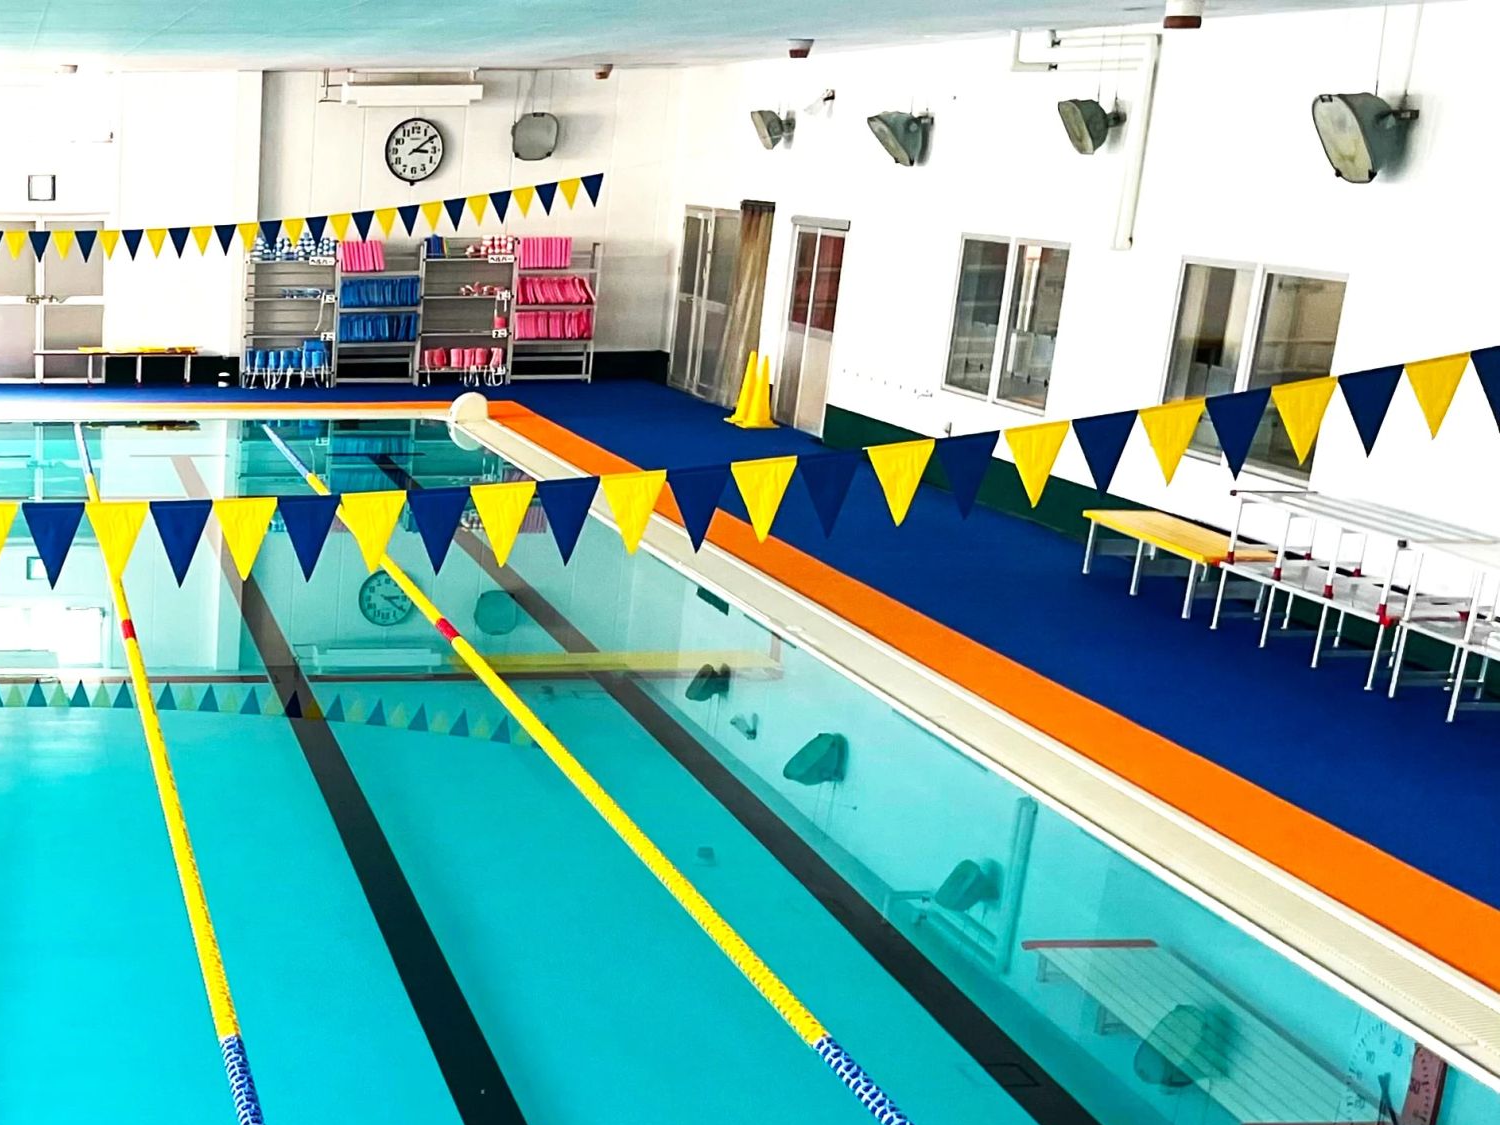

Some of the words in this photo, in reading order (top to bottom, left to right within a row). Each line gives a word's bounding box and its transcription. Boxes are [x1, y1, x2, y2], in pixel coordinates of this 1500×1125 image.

[403, 128, 410, 137] 11
[411, 126, 421, 134] 12
[392, 147, 398, 155] 9
[431, 146, 437, 154] 3
[402, 164, 407, 172] 7
